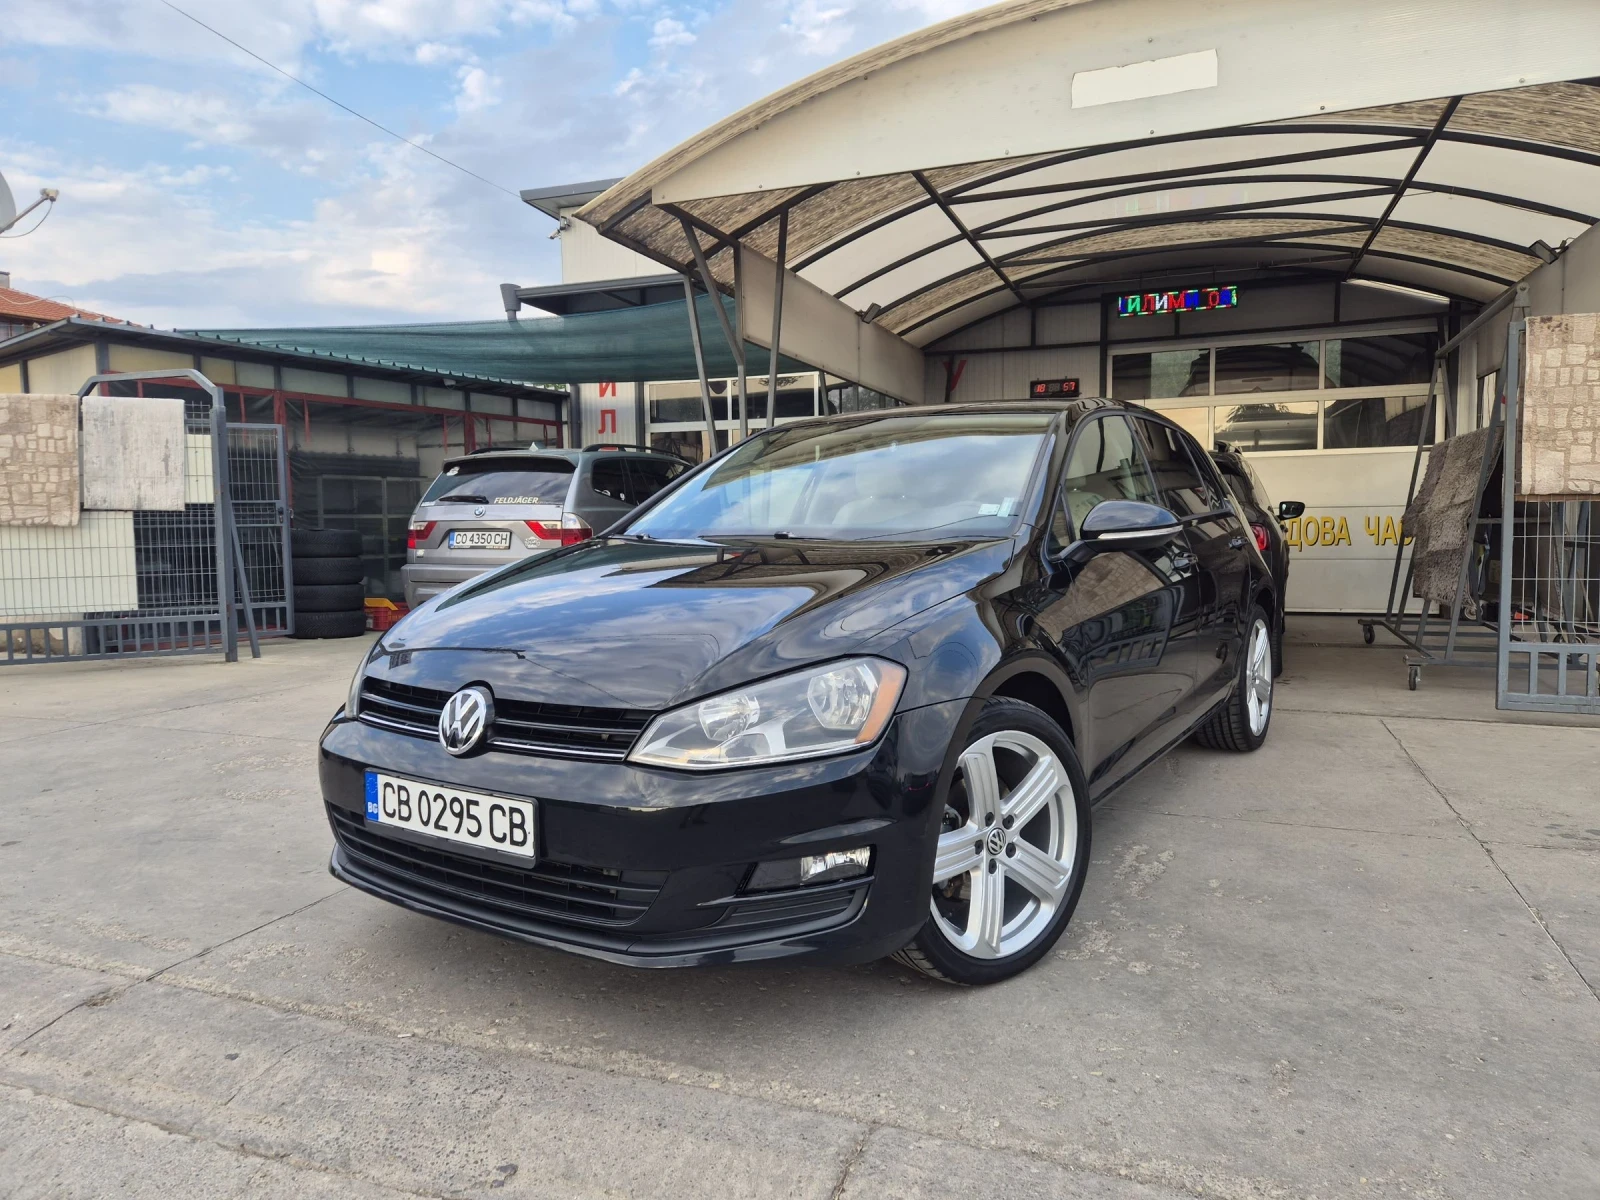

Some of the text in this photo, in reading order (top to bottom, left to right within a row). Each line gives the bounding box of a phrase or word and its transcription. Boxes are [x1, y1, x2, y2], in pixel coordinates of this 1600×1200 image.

[494, 496, 539, 504] FELDJÄGER
[469, 533, 492, 545] 4350
[1282, 515, 1351, 552] ДОВА
[367, 801, 378, 814] BG
[383, 781, 528, 848] CB 0295 CB
